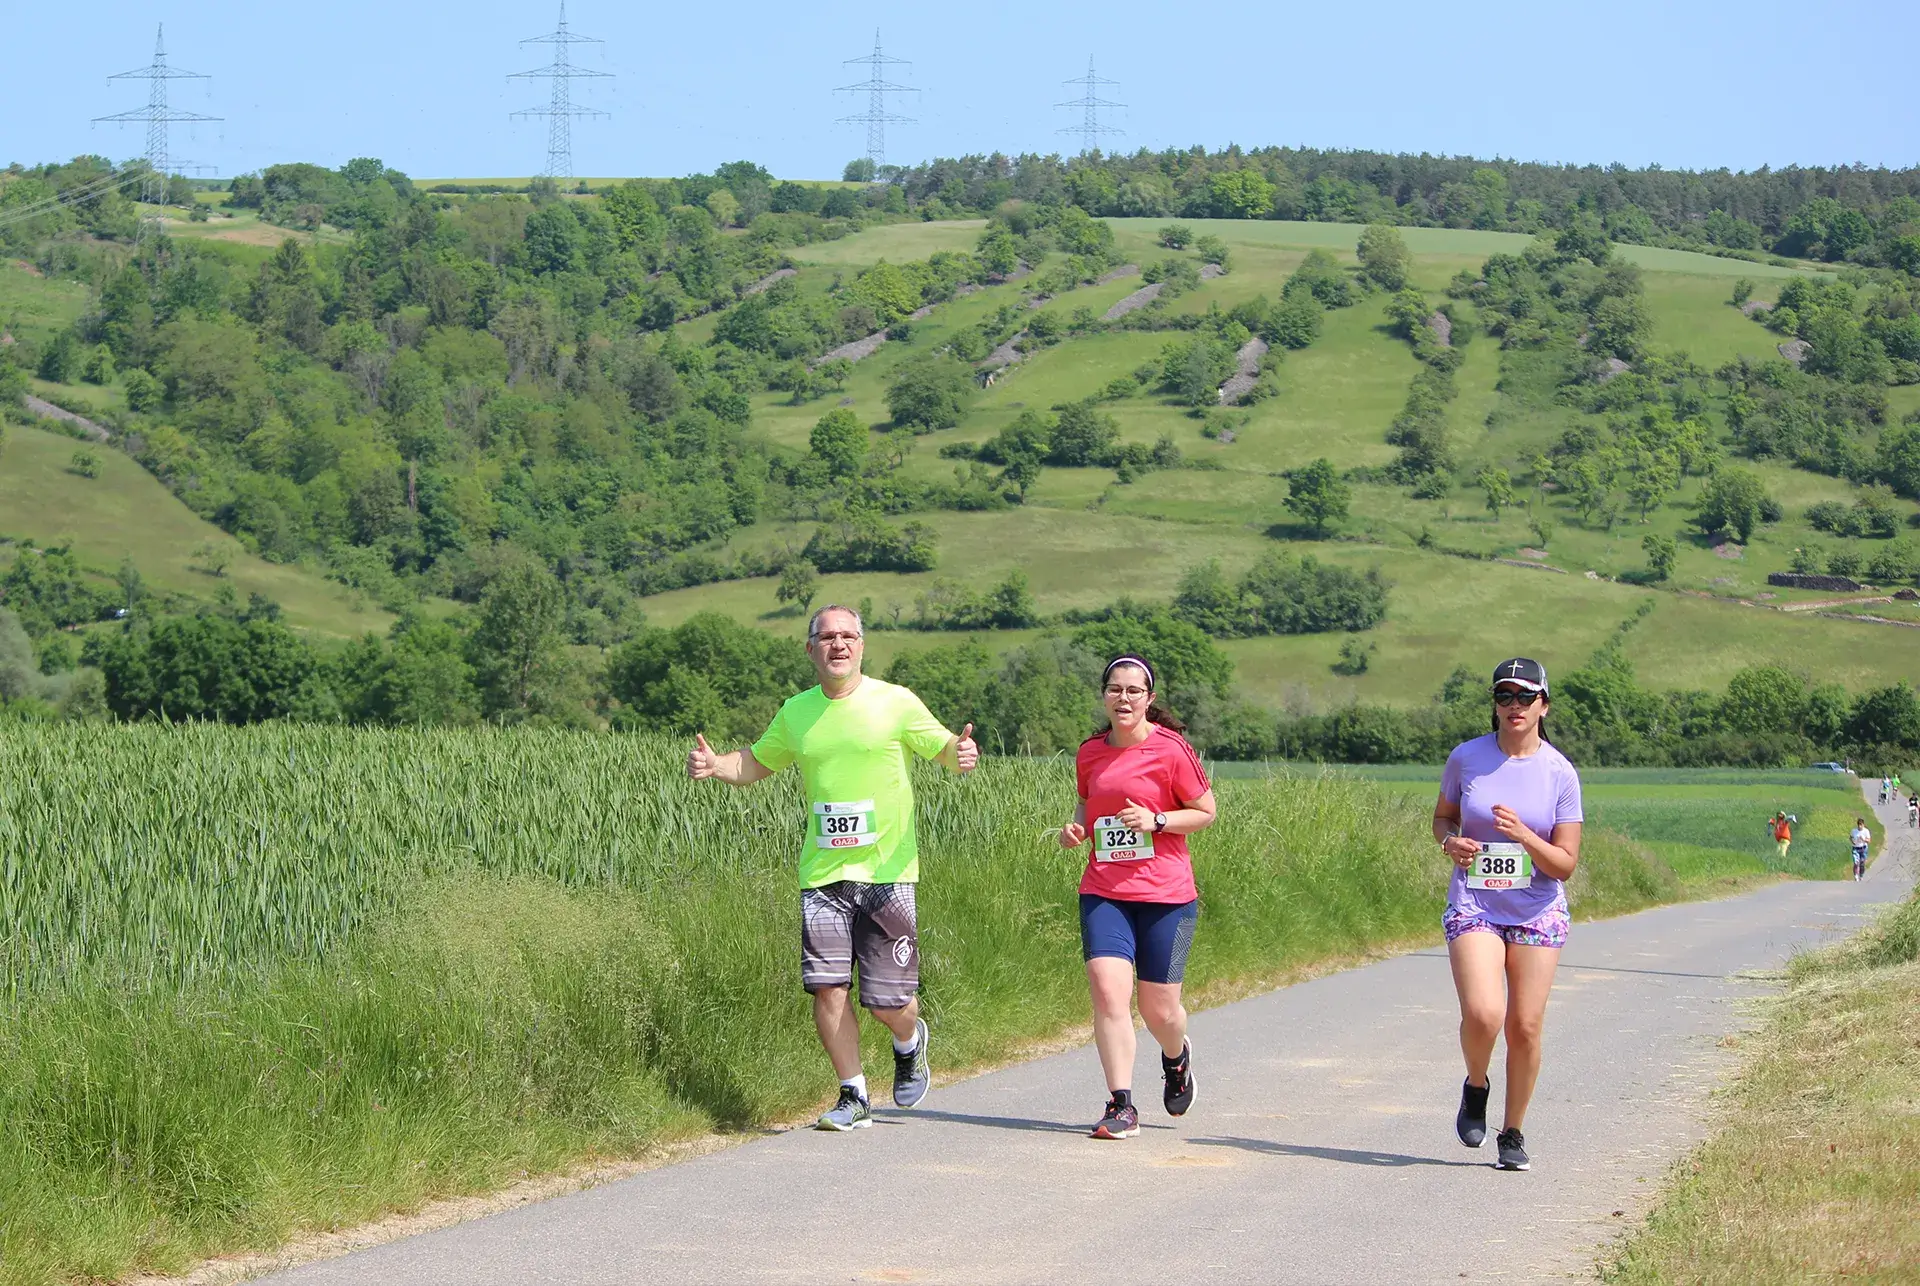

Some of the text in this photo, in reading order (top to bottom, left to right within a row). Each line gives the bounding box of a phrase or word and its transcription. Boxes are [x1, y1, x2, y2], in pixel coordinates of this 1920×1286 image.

[827, 816, 859, 833] 387
[1107, 829, 1137, 847] 323
[1482, 857, 1516, 874] 388
